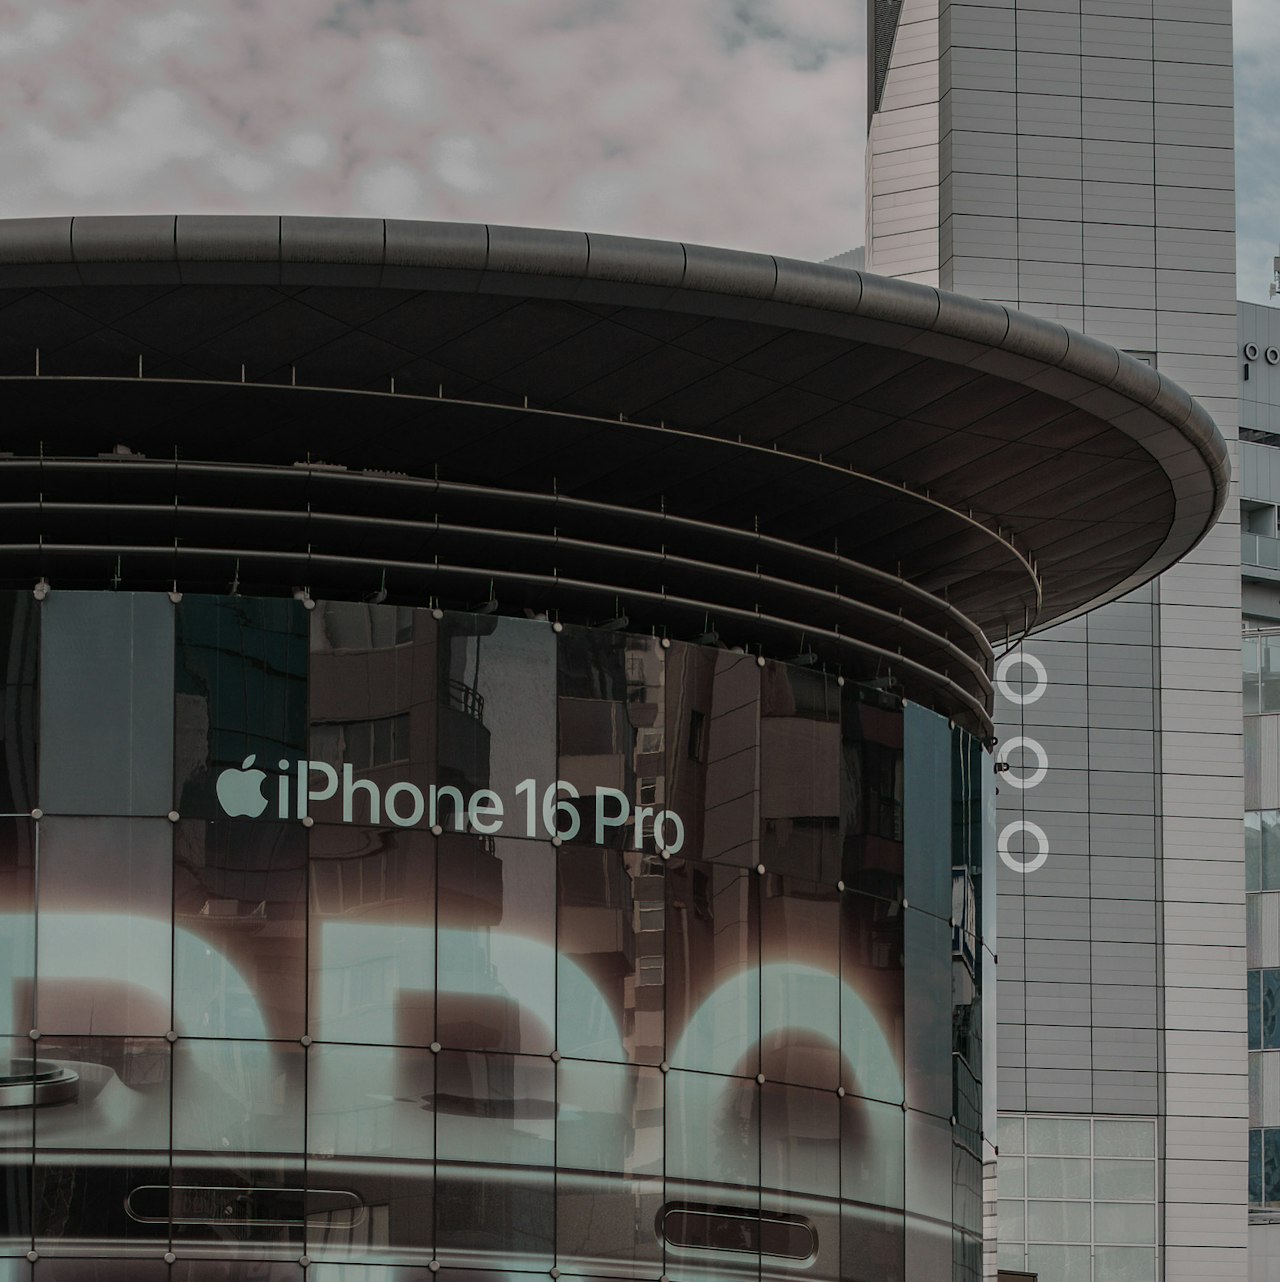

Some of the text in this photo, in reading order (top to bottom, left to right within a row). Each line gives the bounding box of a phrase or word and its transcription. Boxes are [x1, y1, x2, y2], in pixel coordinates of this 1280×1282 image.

[277, 758, 687, 856] iPhone 16 Pro
